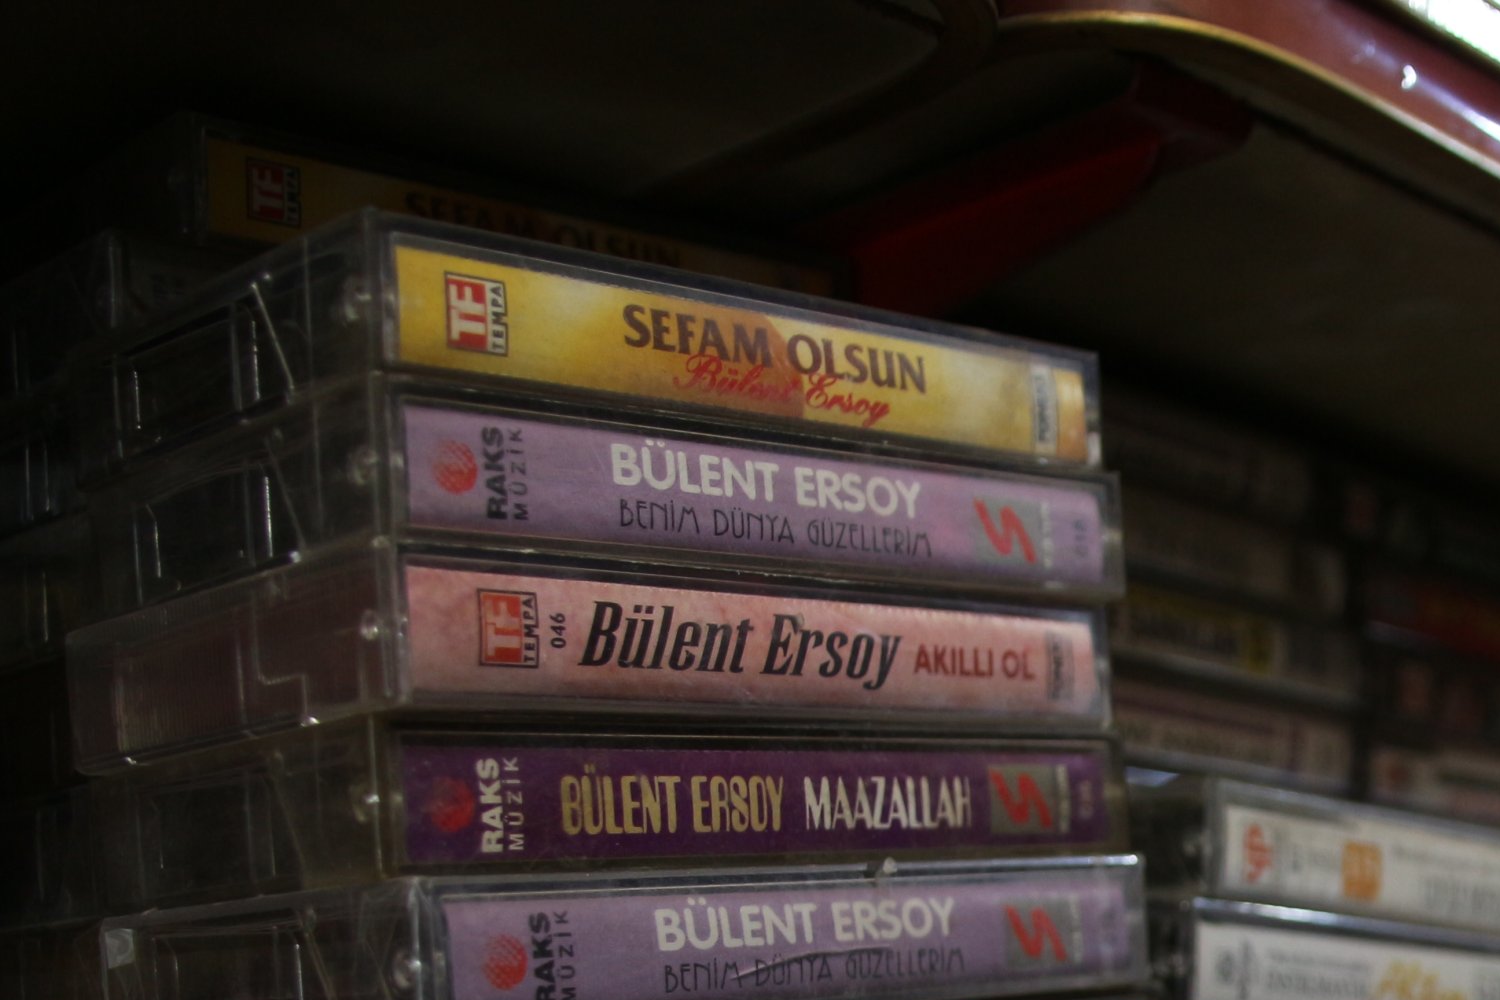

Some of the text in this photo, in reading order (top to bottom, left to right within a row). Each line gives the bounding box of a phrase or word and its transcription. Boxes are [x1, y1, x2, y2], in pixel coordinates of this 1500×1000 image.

[490, 286, 506, 350] TEMPA
[622, 304, 927, 393] SEFAM OLSUN
[672, 353, 890, 428] Bülent Ersoy
[482, 427, 508, 519] RAKS
[507, 428, 529, 520] MÜZİK
[610, 439, 921, 519] BÜLENT ERSOY
[620, 499, 932, 558] BENİM DÜNYA GÜZELLERİM
[524, 598, 538, 663] TEMPA
[550, 613, 565, 648] 046
[577, 601, 753, 673] Bülent
[760, 614, 902, 690] Ersoy
[914, 644, 994, 677] AKILLI
[1002, 649, 1035, 681] OL
[475, 758, 503, 853] RAKS
[502, 757, 525, 850] MÜZİK
[560, 764, 972, 835] BÜLENT ERSOY MAAZALLAH
[654, 897, 954, 951] BÜLENT ERSOY
[664, 957, 743, 993] BENİM
[756, 953, 832, 987] DÜNYA
